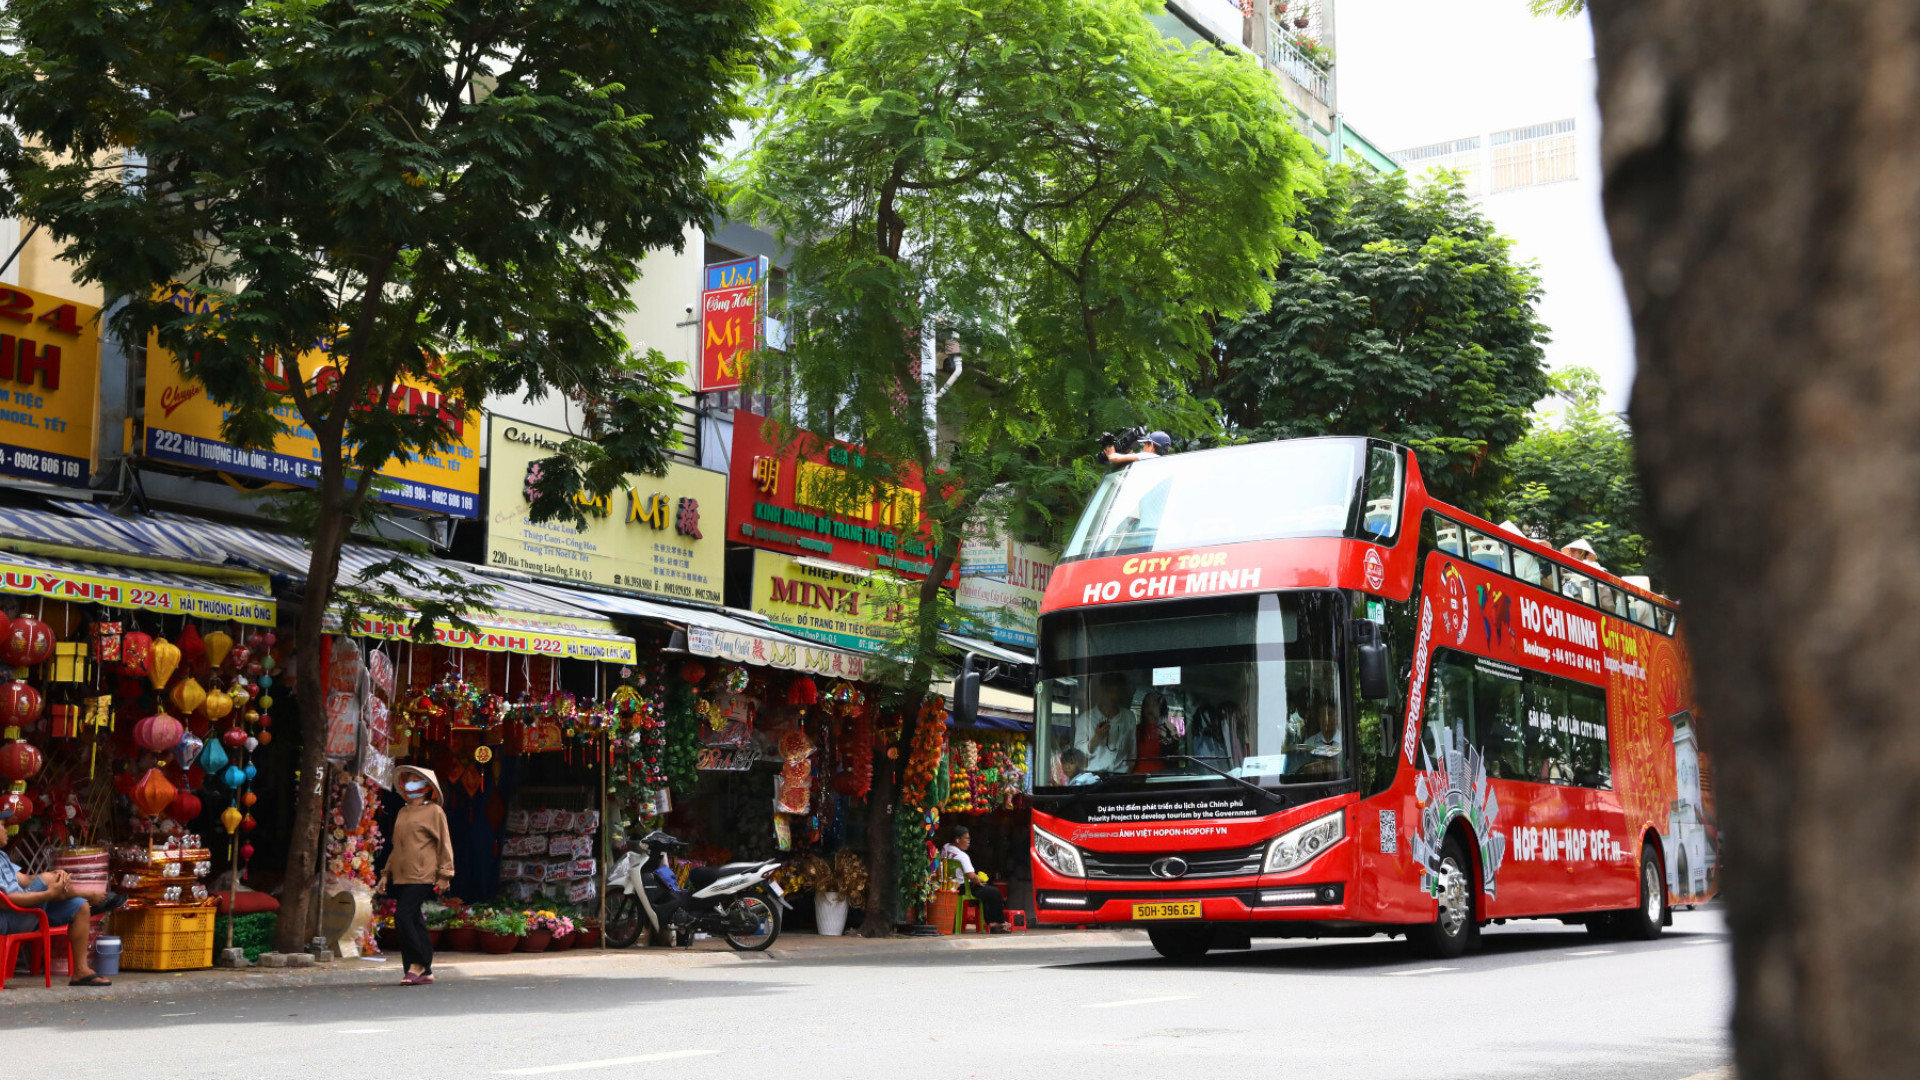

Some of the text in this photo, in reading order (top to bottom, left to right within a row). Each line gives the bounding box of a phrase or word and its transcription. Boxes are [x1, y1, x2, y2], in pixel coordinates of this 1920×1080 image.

[706, 317, 740, 350] Mi
[155, 429, 182, 453] 222
[14, 451, 39, 471] 0902
[41, 456, 60, 474] 606
[62, 461, 80, 478] 169
[755, 456, 780, 496] 明
[625, 486, 671, 531] Mi
[754, 501, 781, 524] KINH
[783, 508, 815, 532] DOANH
[833, 520, 863, 543] TRANG
[492, 550, 508, 565] 220
[1123, 552, 1228, 575] CITY TOUR
[0, 570, 122, 602] UỲNH
[129, 588, 172, 609] 224
[180, 594, 195, 611] HẢI
[770, 576, 860, 616] MINH
[1082, 568, 1262, 603] HO CHI MINH
[810, 616, 834, 631] TRANG
[1520, 596, 1540, 633] HO
[1542, 605, 1566, 640] CHI
[1566, 612, 1599, 650] MINH
[533, 638, 563, 654] 222
[769, 640, 830, 672] Mi Mi
[316, 766, 324, 780] 5
[313, 782, 323, 796] 4
[1088, 815, 1110, 823] Priority
[1111, 814, 1132, 823] Project
[1141, 812, 1166, 822] develop
[1167, 811, 1192, 819] tourism
[1193, 811, 1201, 820] by
[1202, 810, 1213, 818] the
[1215, 808, 1257, 817] Government
[1174, 802, 1183, 810] du
[1153, 827, 1214, 838] HOPON-HOPOFF
[1216, 826, 1227, 835] VN
[1513, 826, 1538, 861] HOP
